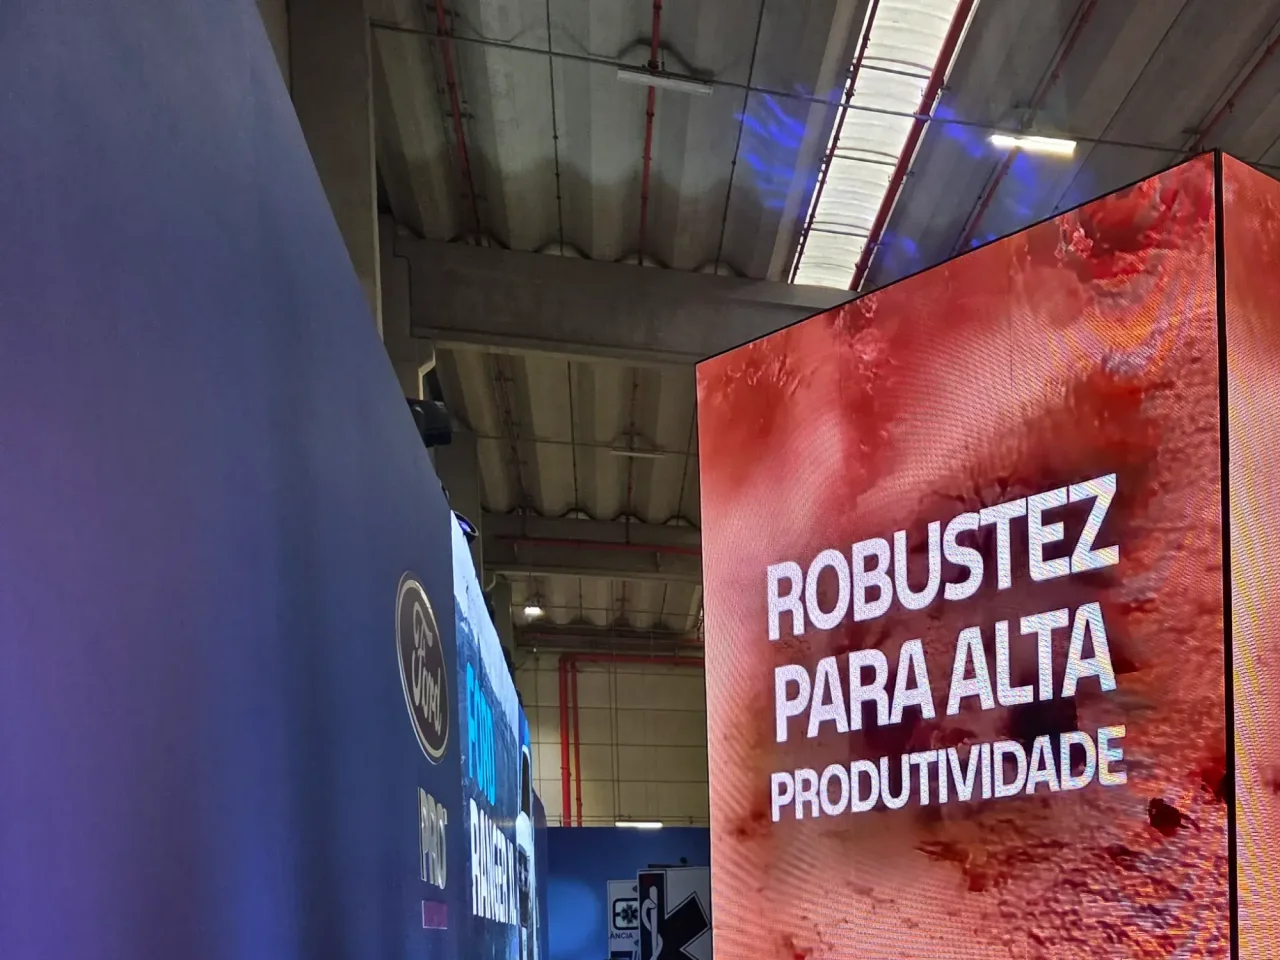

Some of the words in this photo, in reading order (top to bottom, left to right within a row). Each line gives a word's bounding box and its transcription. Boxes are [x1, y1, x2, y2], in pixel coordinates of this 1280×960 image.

[767, 473, 1119, 640] ROBUSTEZ
[412, 601, 443, 736] Ford
[467, 662, 495, 806] FORD
[774, 639, 935, 742] PARA
[946, 601, 1117, 716] ALTA
[418, 787, 448, 890] PRO
[771, 725, 1127, 822] PRODUTIVIDADE
[469, 798, 508, 924] RANGER
